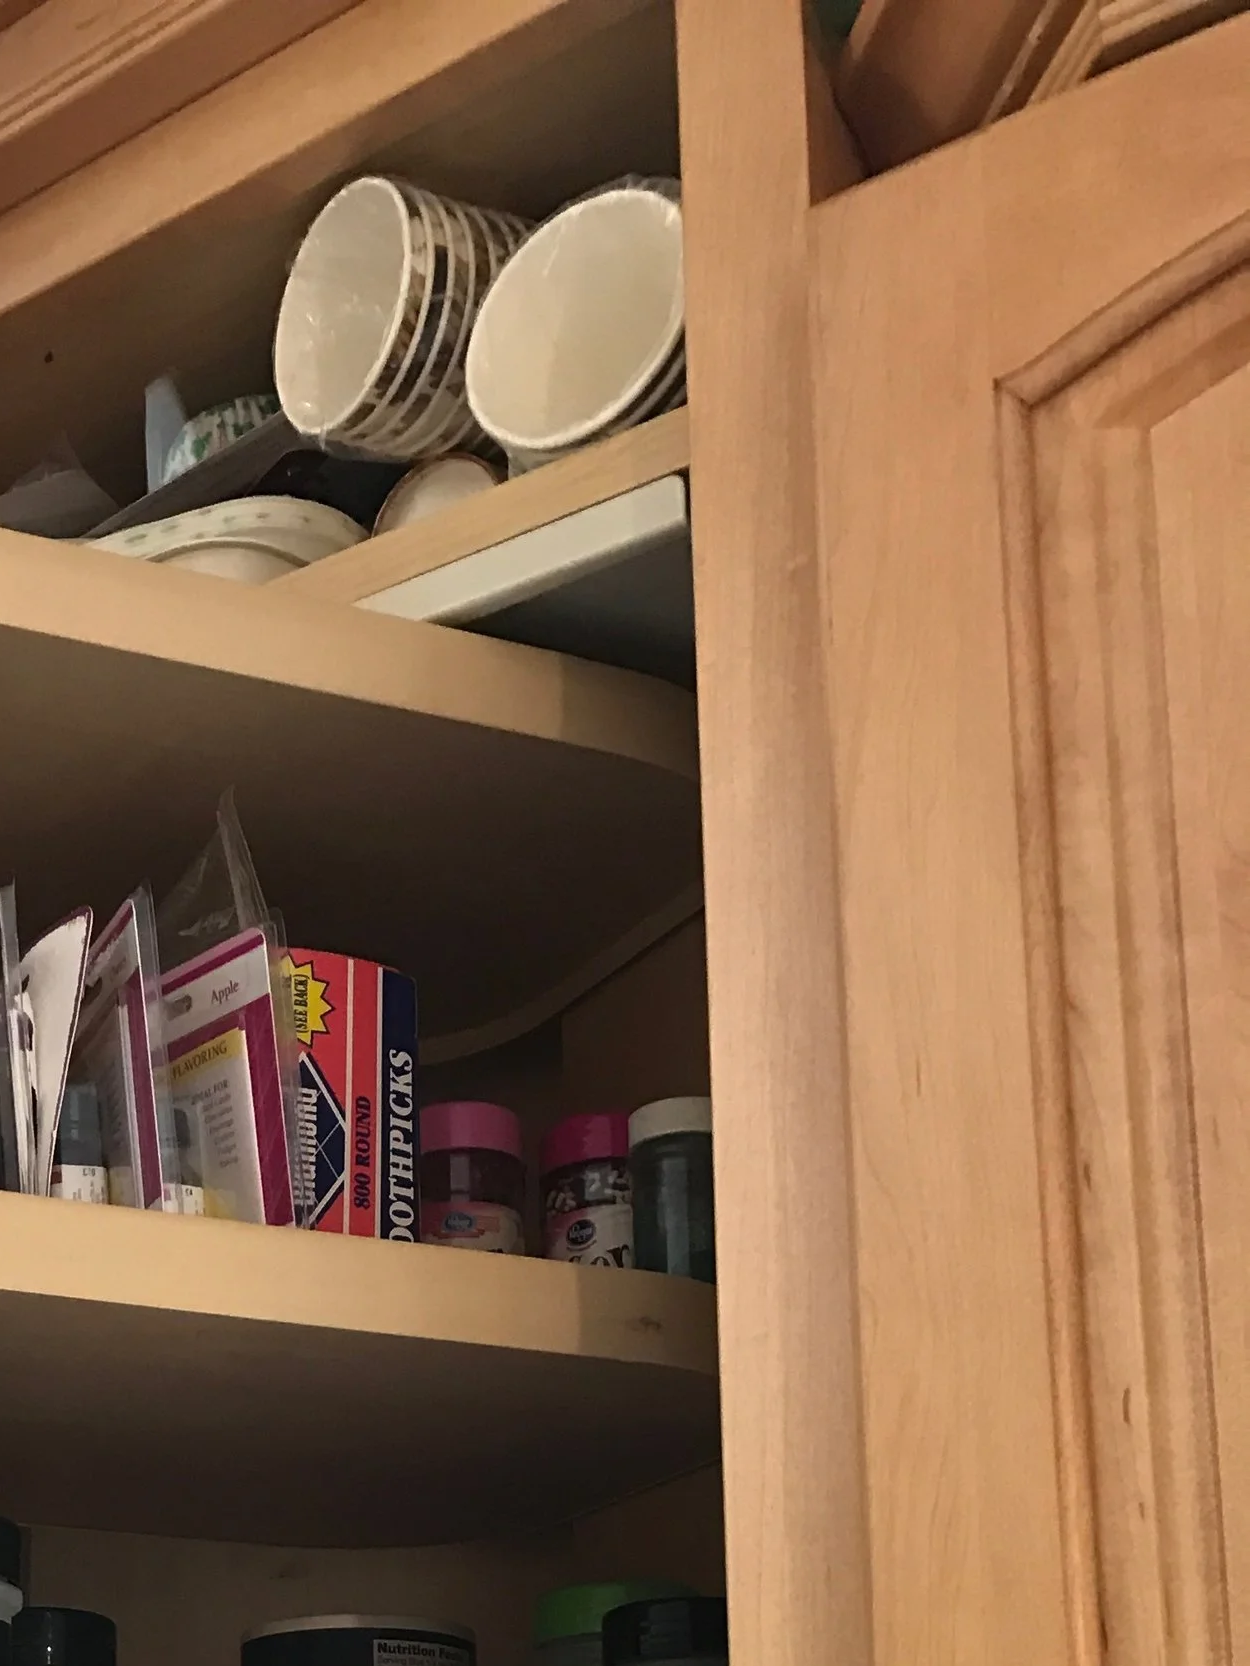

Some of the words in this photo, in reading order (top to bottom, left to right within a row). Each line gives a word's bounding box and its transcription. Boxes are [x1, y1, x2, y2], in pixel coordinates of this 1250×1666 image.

[210, 979, 239, 1004] Apple
[293, 974, 310, 1010] BACK)
[172, 1040, 228, 1080] FLAVORING
[355, 1095, 371, 1168] ROUND
[389, 1048, 415, 1244] OOTHPICKS
[353, 1175, 371, 1210] 800
[377, 1642, 436, 1657] Nutrition
